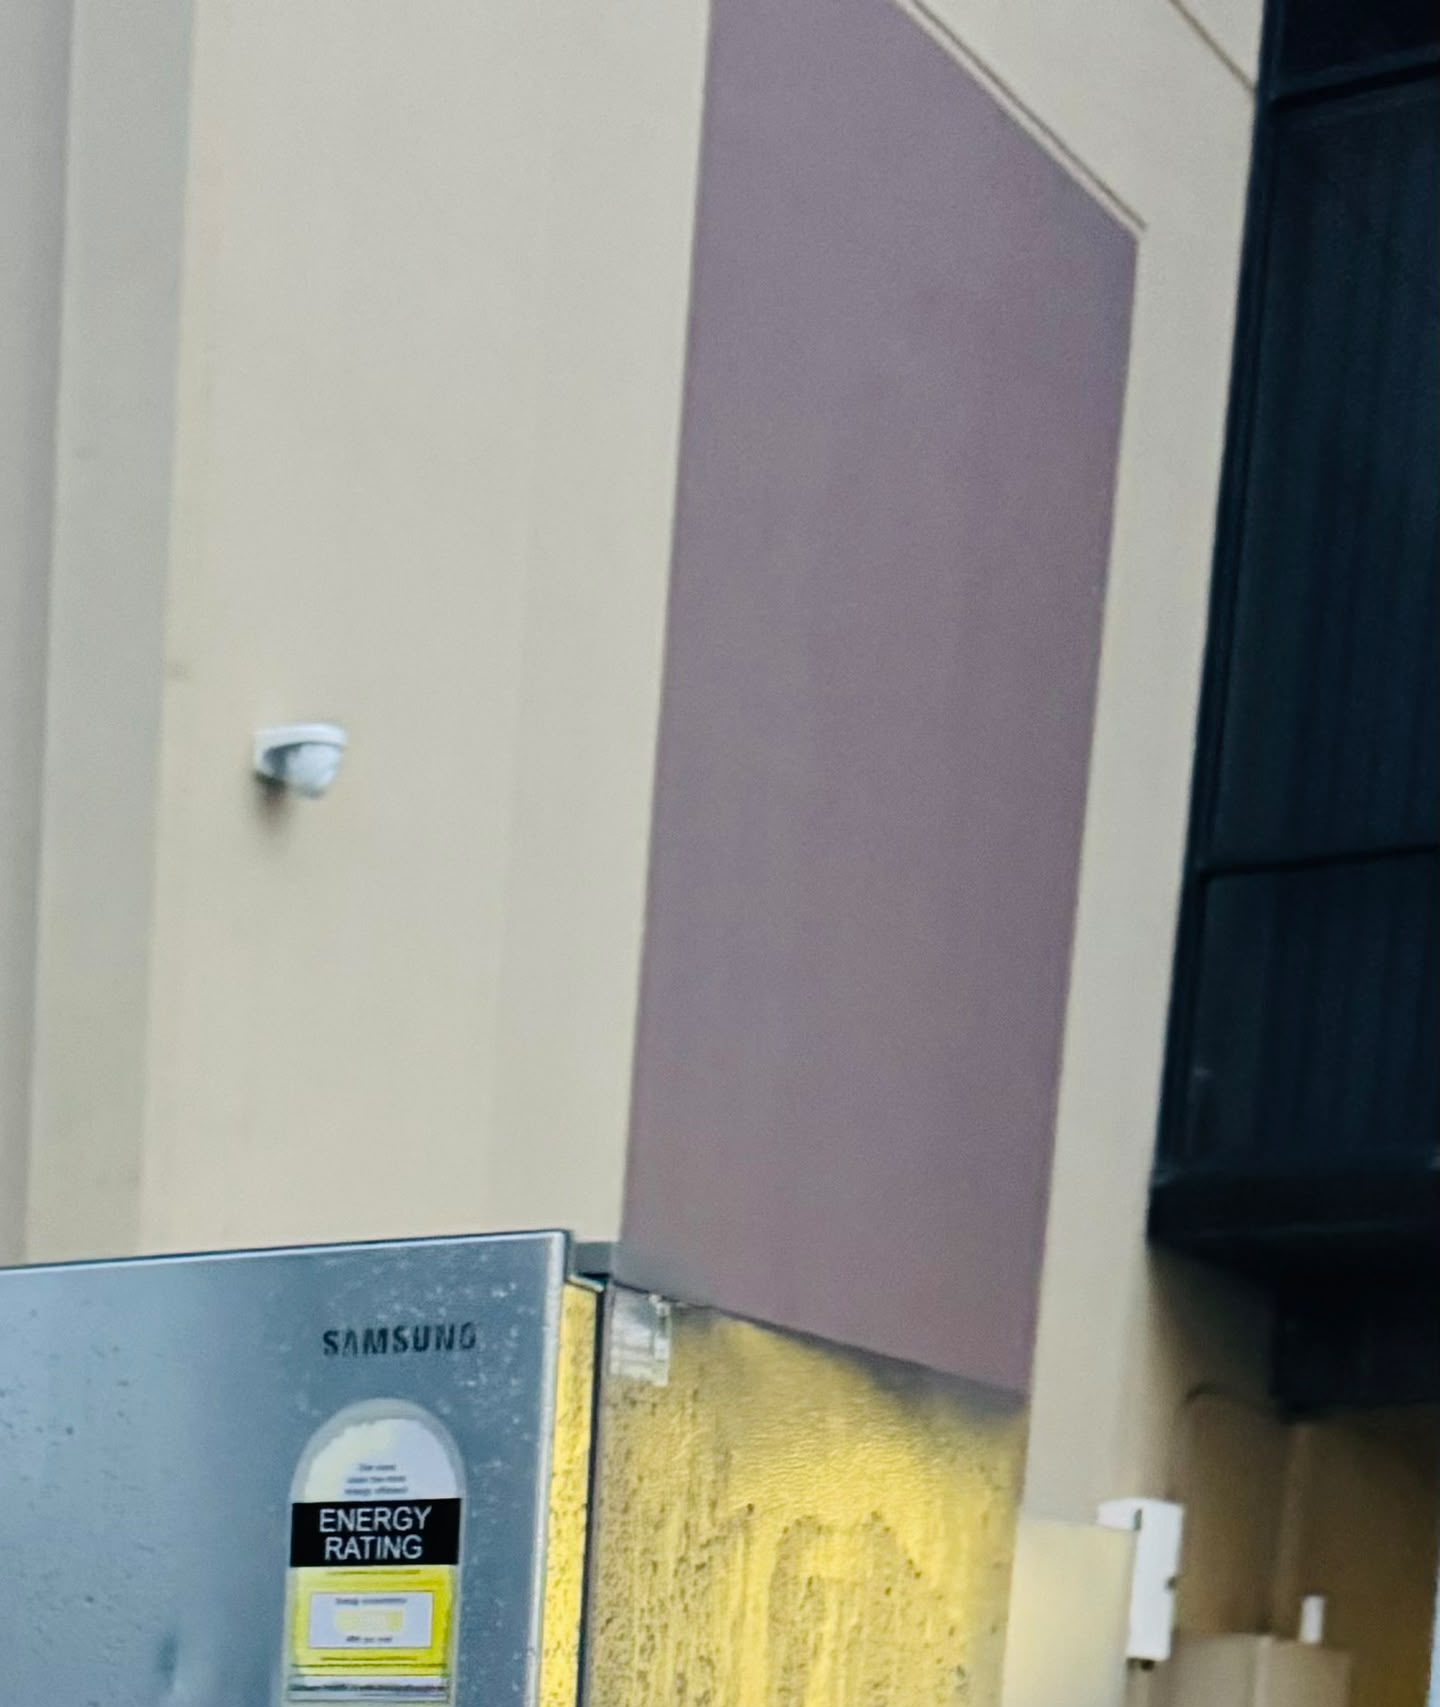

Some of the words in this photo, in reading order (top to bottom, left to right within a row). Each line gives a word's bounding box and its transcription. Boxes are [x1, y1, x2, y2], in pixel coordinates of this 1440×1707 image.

[323, 1322, 476, 1357] SAMSUNG
[320, 1505, 432, 1532] ENERGY
[325, 1534, 423, 1560] RATING
